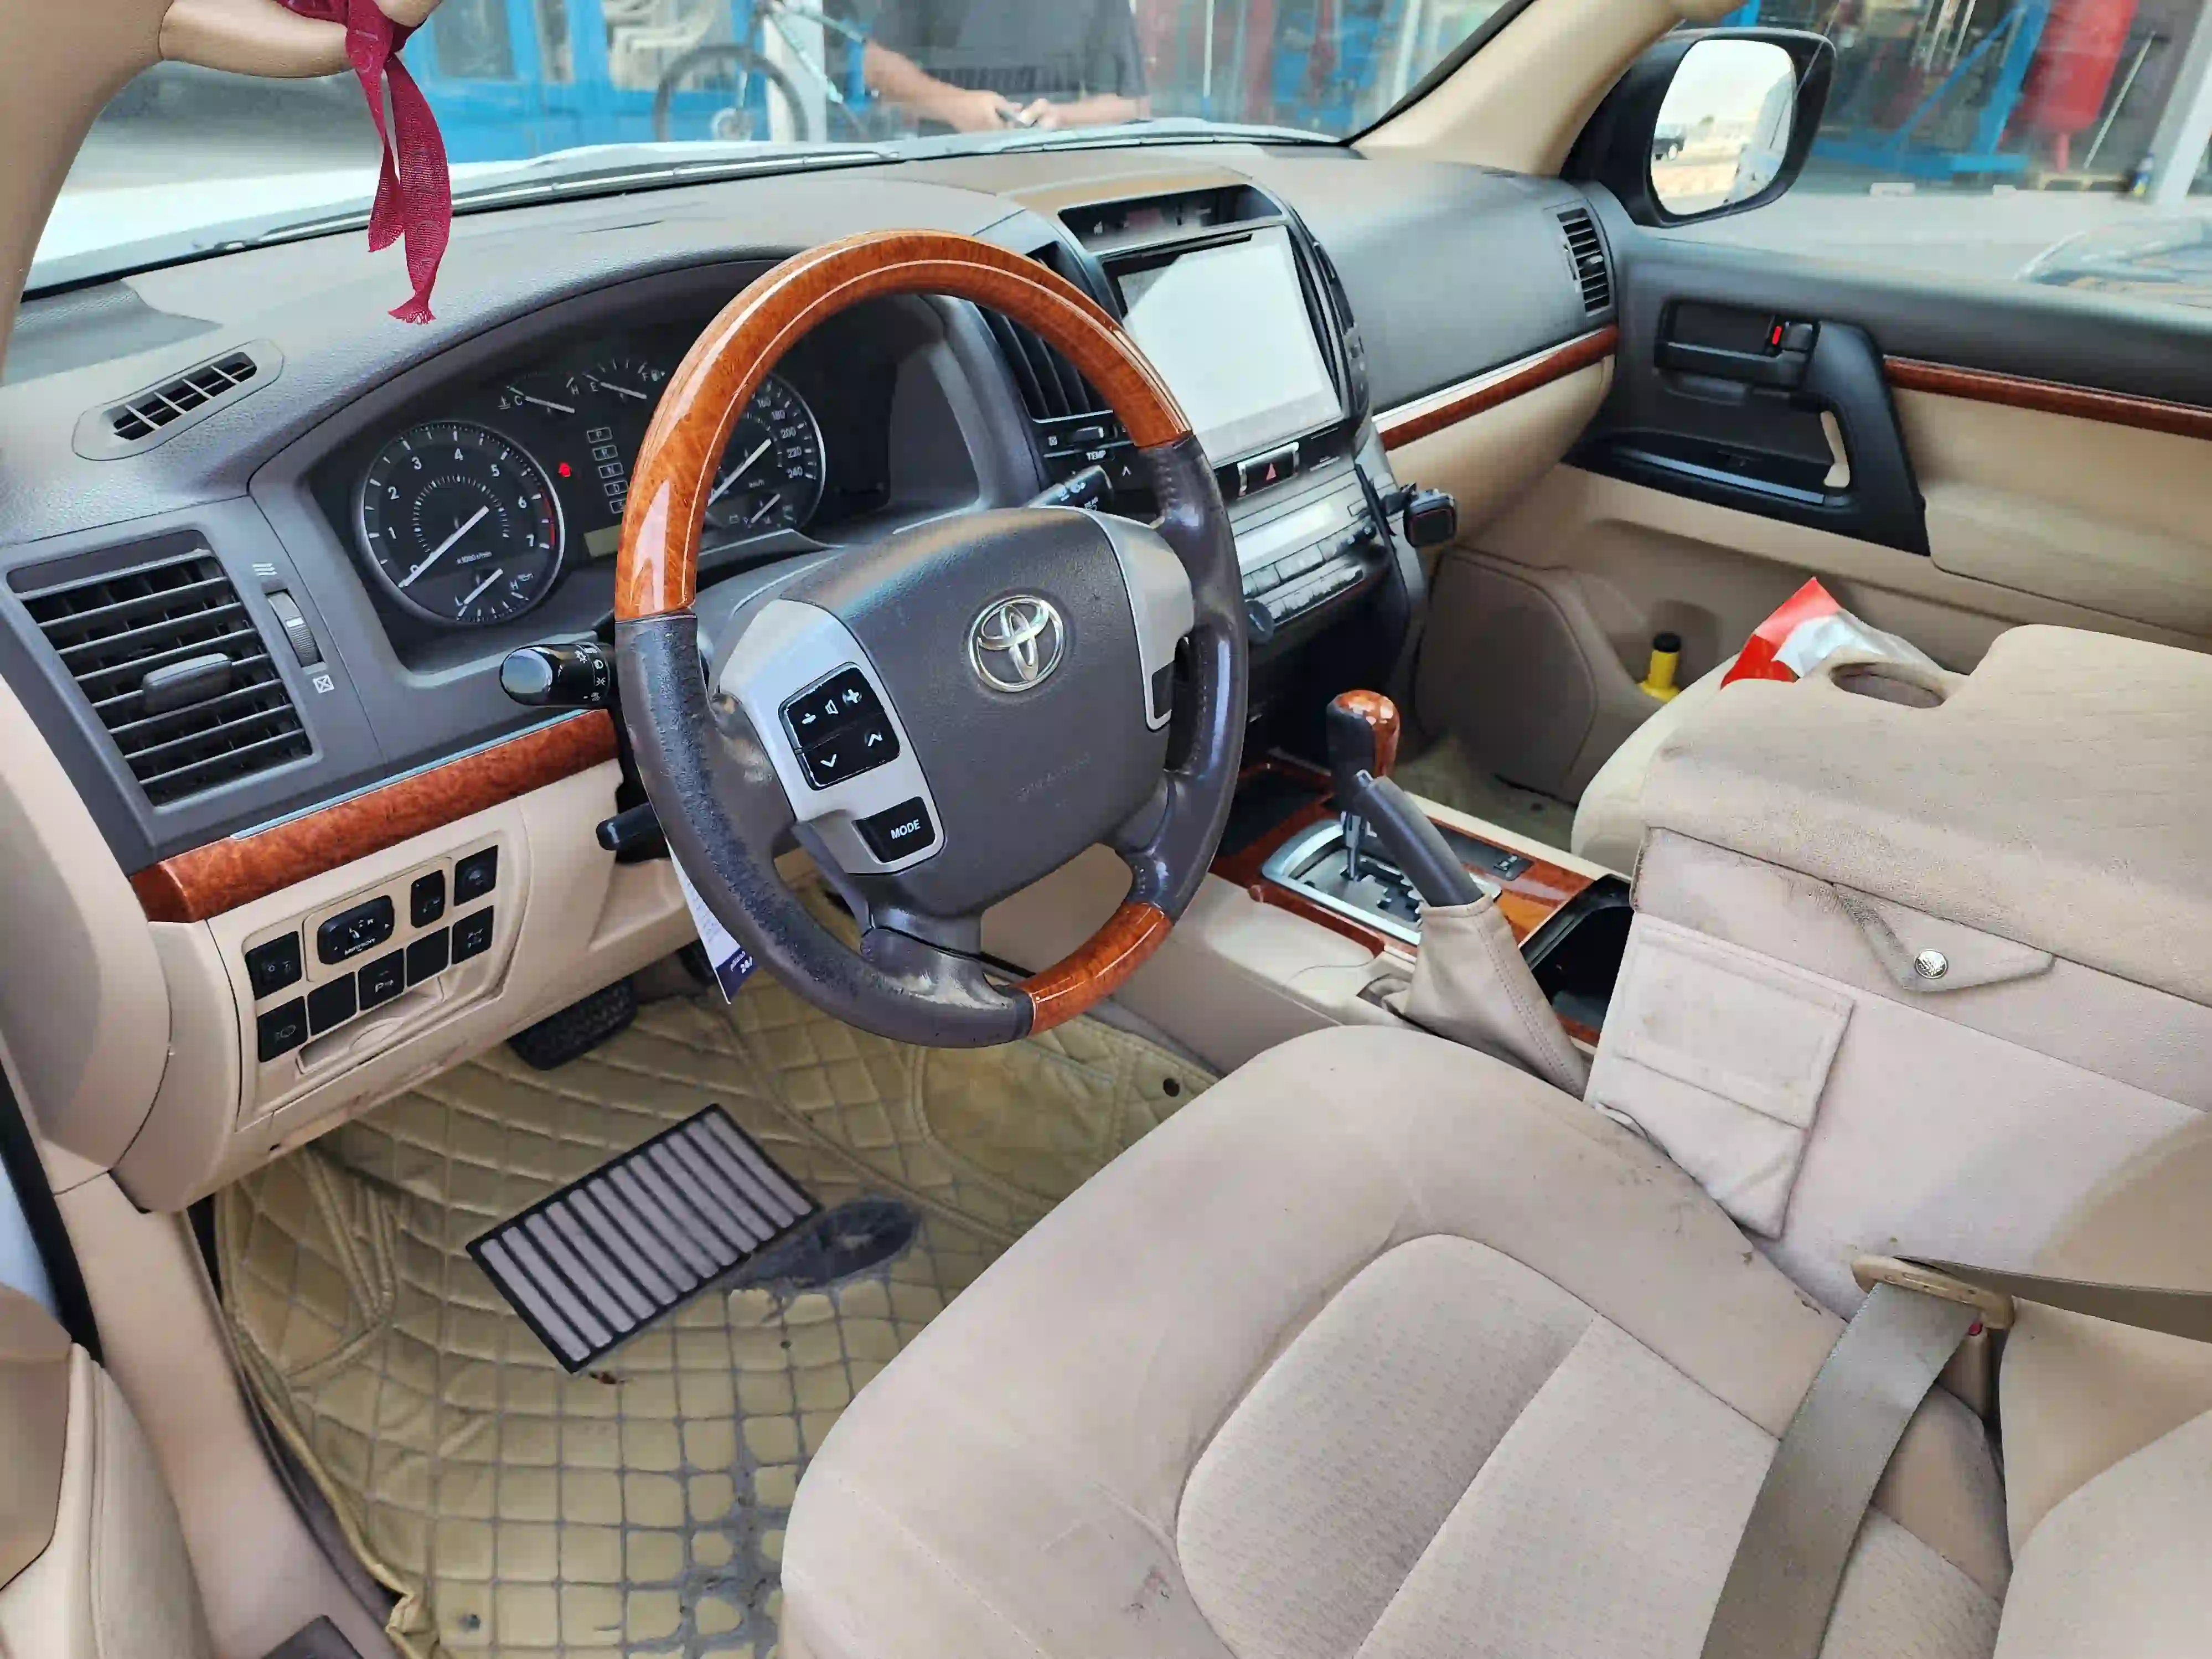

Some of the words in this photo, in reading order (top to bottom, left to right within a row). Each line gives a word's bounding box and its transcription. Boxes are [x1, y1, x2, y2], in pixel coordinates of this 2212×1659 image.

[780, 427, 797, 439] 200
[454, 448, 464, 461] 4
[411, 456, 422, 470] 3
[490, 463, 500, 477] 5
[387, 486, 400, 500] 2
[518, 496, 528, 509] 6
[388, 526, 397, 540] 1
[526, 534, 535, 547] 7
[890, 819, 921, 840] MODE
